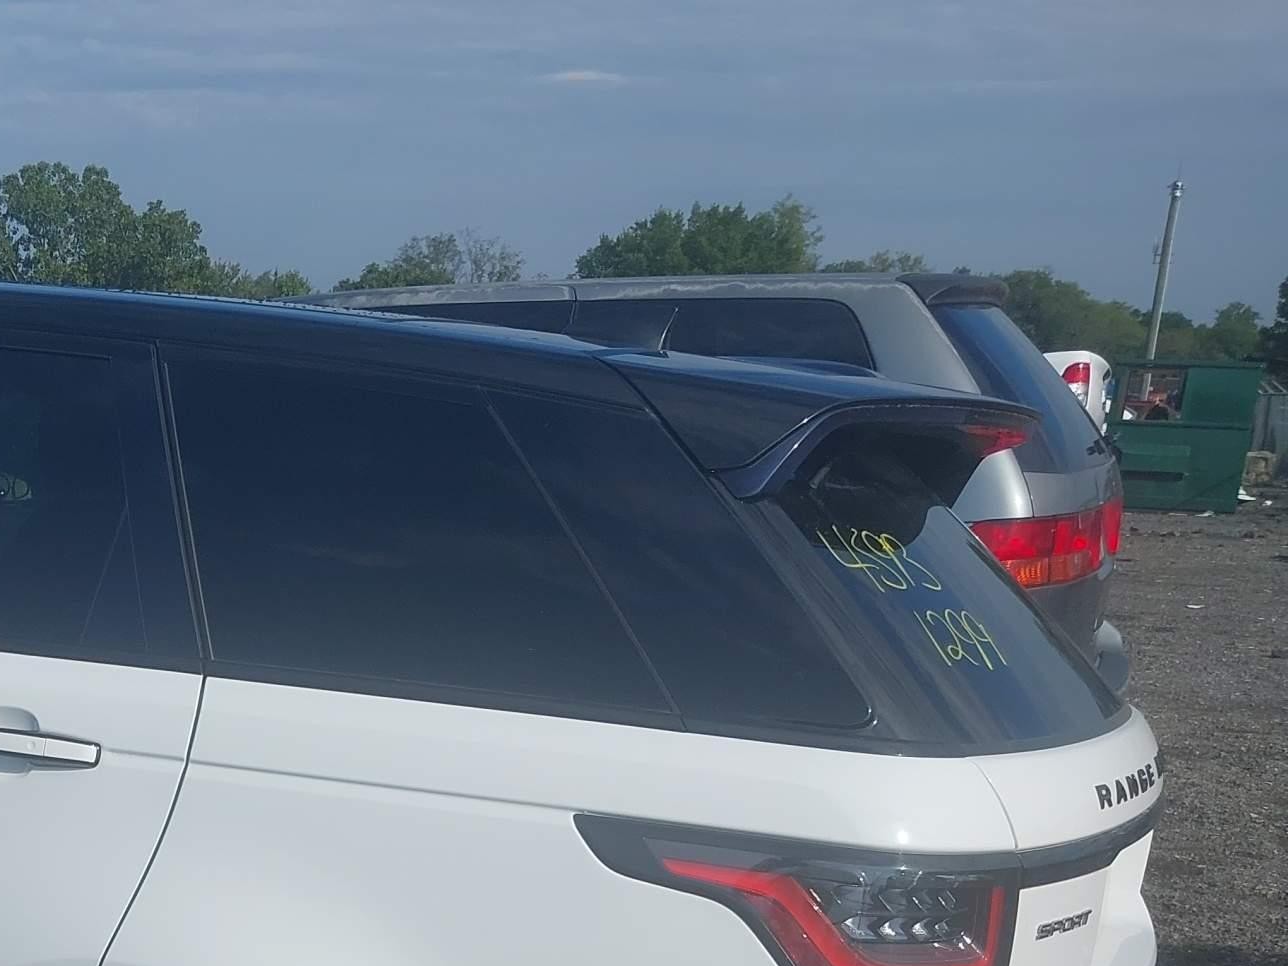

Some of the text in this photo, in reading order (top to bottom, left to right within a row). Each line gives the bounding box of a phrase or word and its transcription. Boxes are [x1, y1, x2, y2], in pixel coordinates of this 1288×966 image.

[914, 608, 1008, 671] 1299
[1095, 763, 1155, 810] RANGE
[1035, 909, 1092, 941] SPORT
